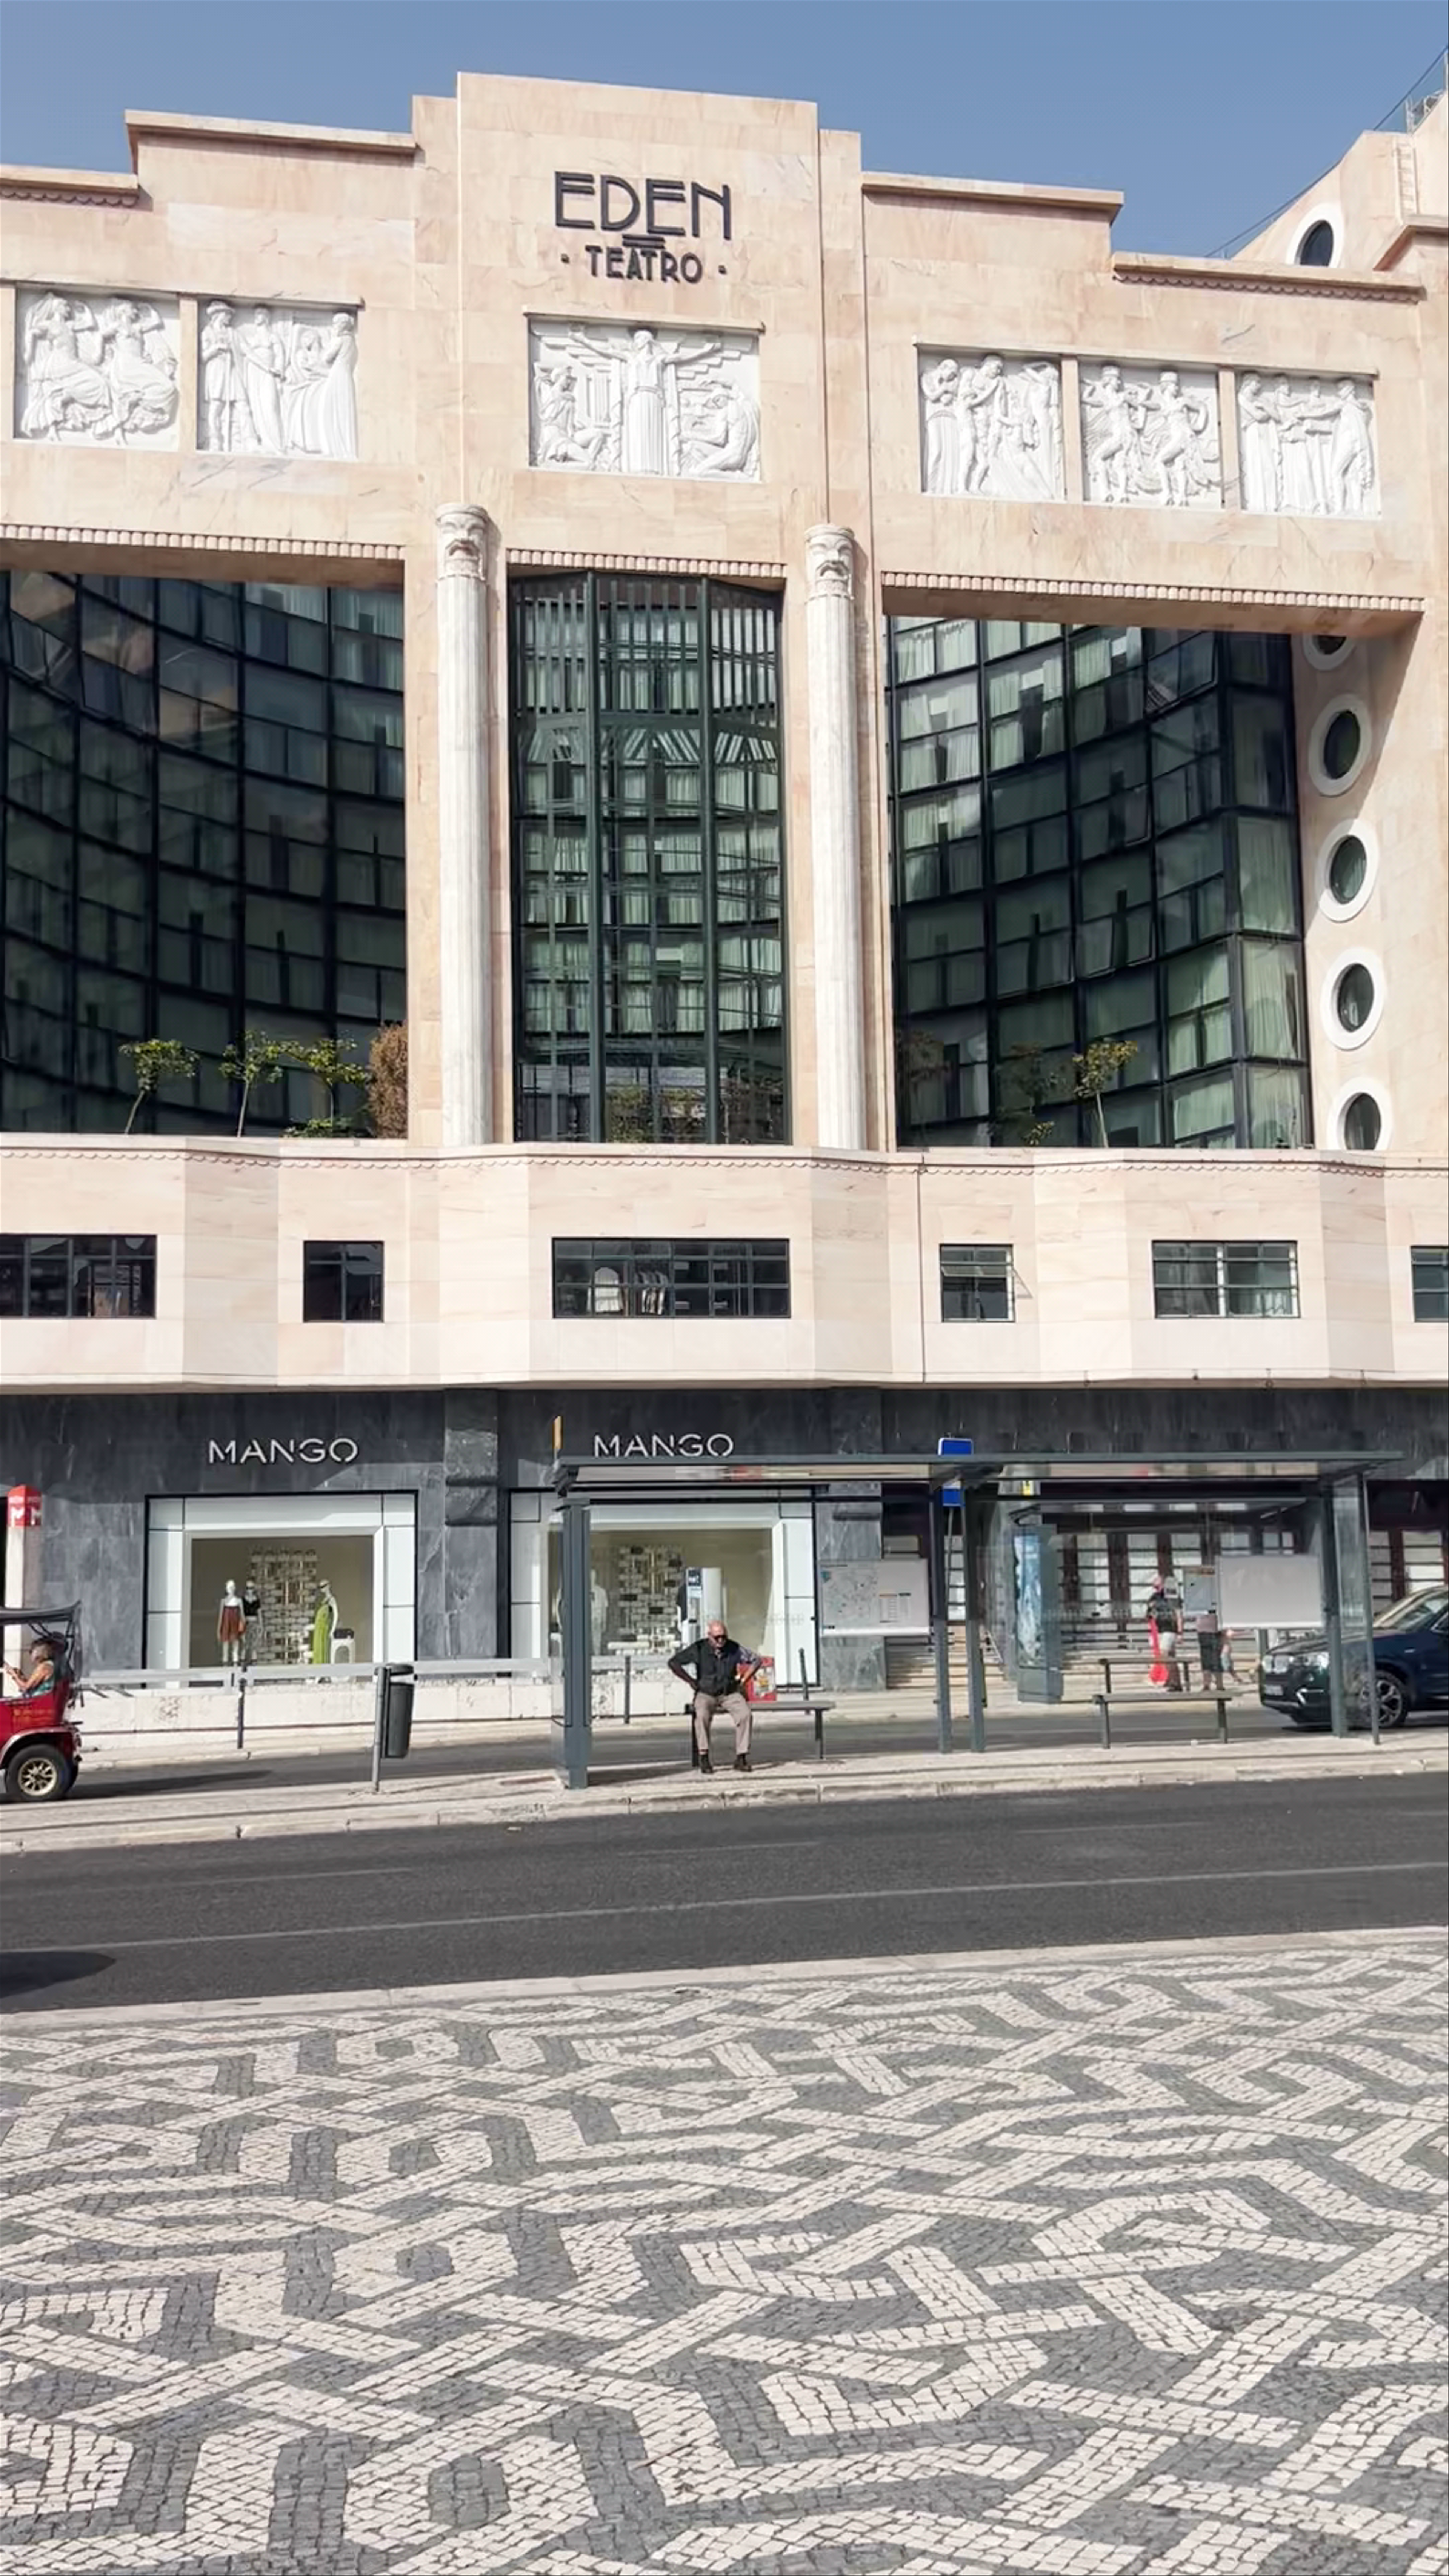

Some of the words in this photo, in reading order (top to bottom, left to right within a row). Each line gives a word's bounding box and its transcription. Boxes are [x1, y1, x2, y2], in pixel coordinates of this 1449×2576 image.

[555, 171, 731, 240] EDEN
[585, 245, 703, 283] TEATRO
[209, 1438, 358, 1463] MANGO
[595, 1434, 733, 1457] MANGO
